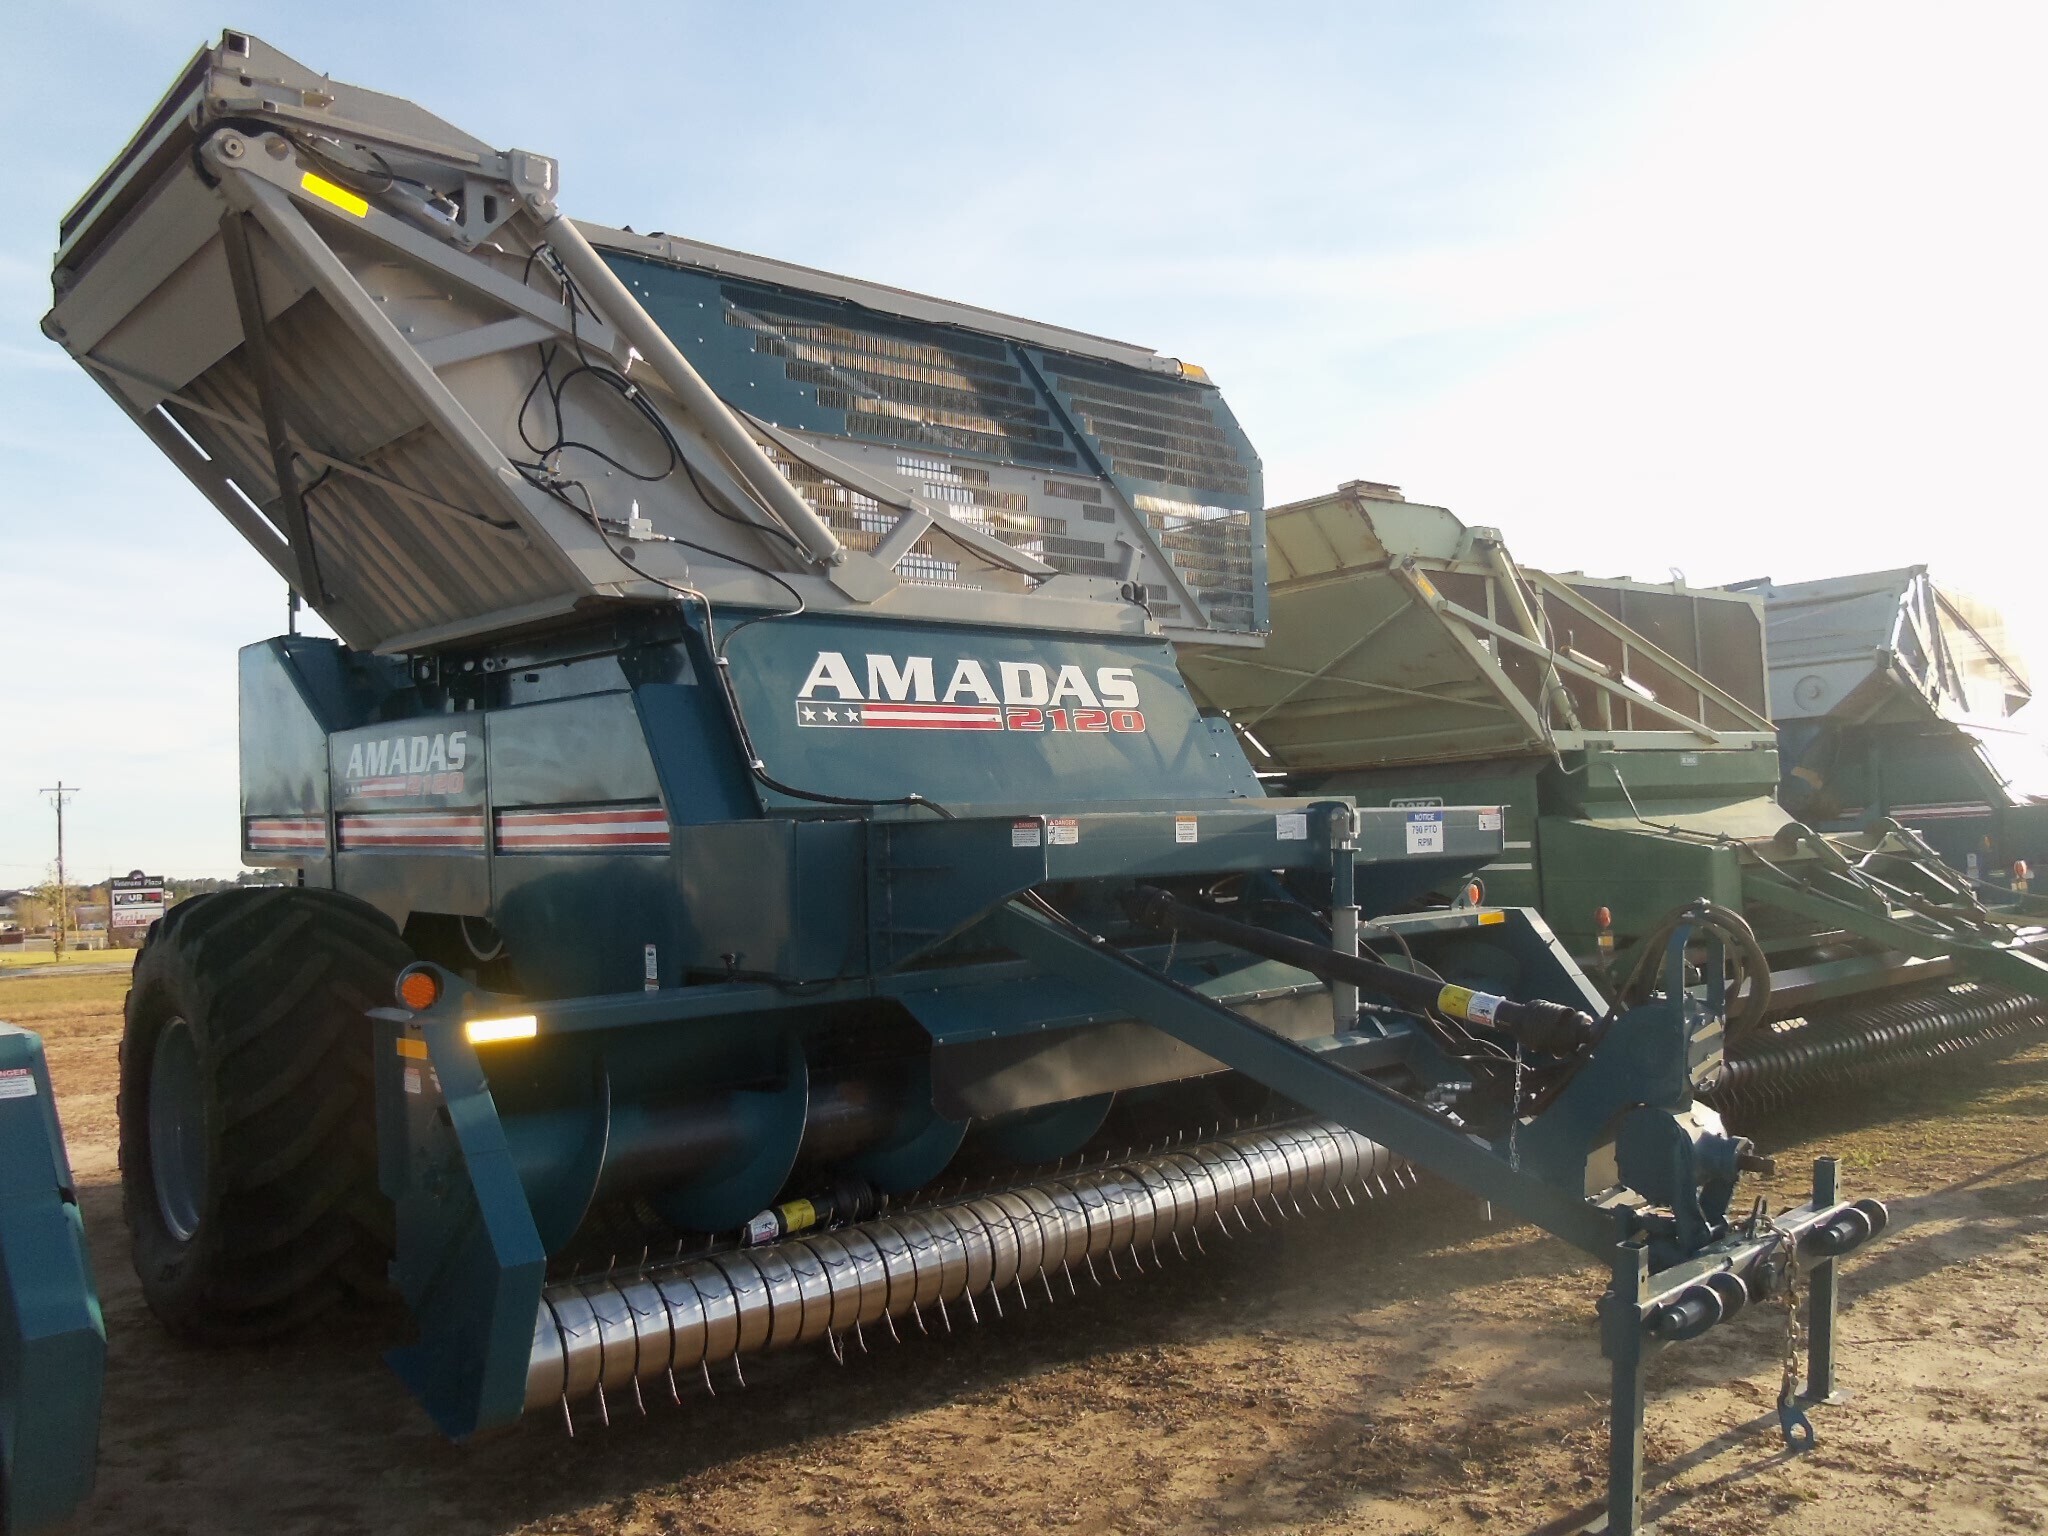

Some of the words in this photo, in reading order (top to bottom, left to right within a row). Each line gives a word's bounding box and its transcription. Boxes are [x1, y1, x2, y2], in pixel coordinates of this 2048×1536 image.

[797, 651, 1140, 708] AMADAS
[1006, 706, 1146, 733] 2120
[346, 730, 467, 778] AMADAS
[406, 772, 466, 796] 2120
[1414, 813, 1434, 821] NOTICE
[1412, 825, 1423, 834] 790
[1424, 825, 1437, 833] PTO
[1417, 838, 1432, 846] RPM
